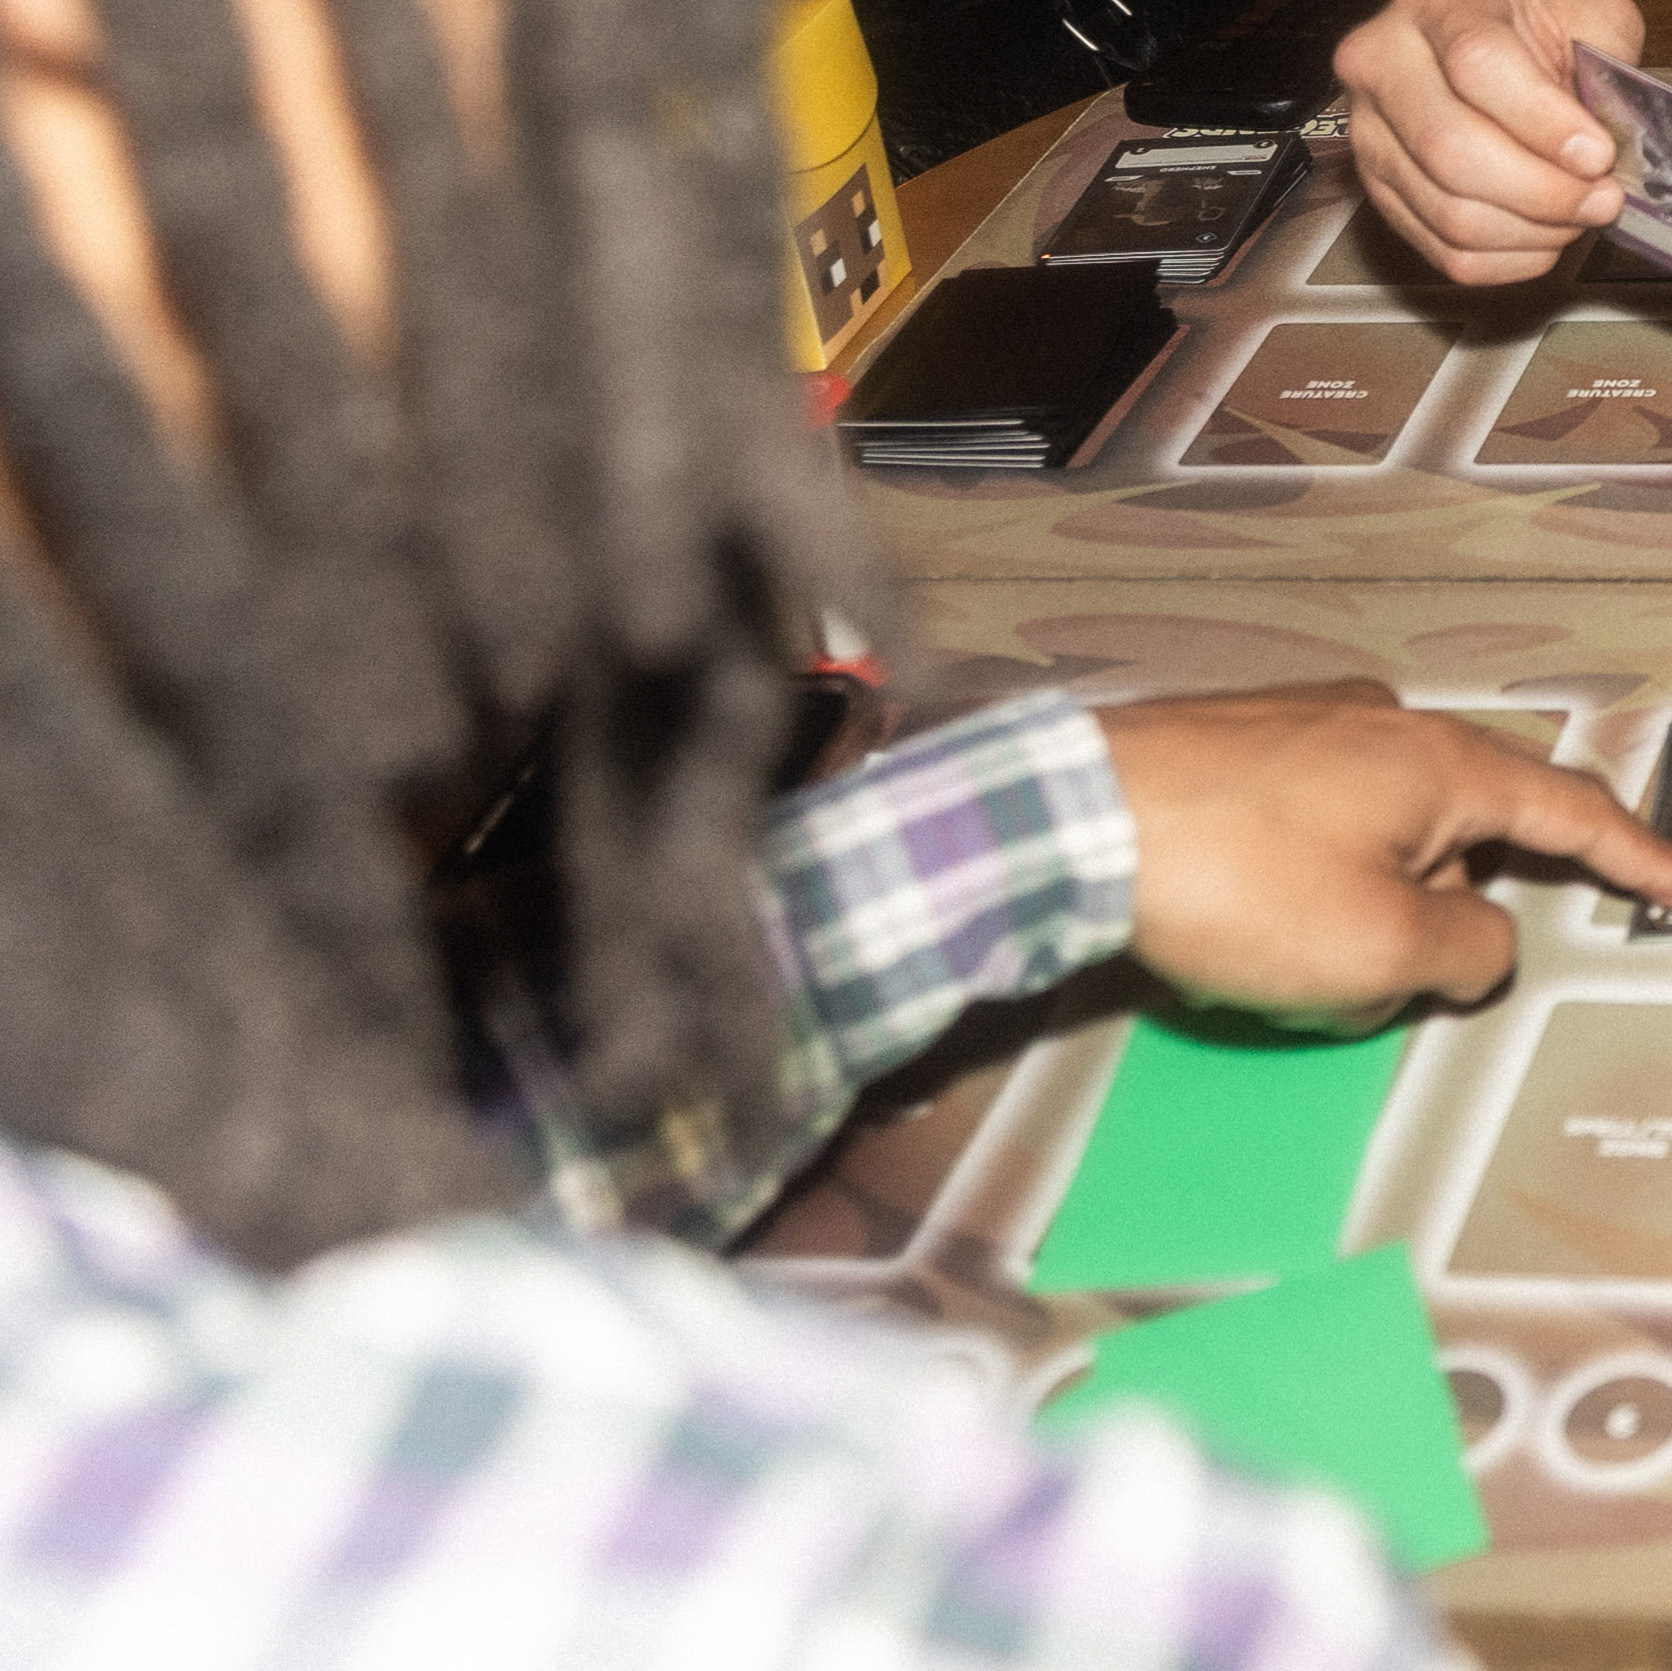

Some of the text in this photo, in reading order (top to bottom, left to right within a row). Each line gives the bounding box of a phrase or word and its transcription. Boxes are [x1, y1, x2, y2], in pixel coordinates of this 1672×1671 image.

[1305, 380, 1356, 389] ZONE
[1591, 379, 1642, 388] ZONE
[1279, 390, 1369, 400] CREATURE
[1566, 389, 1657, 399] CREATURE
